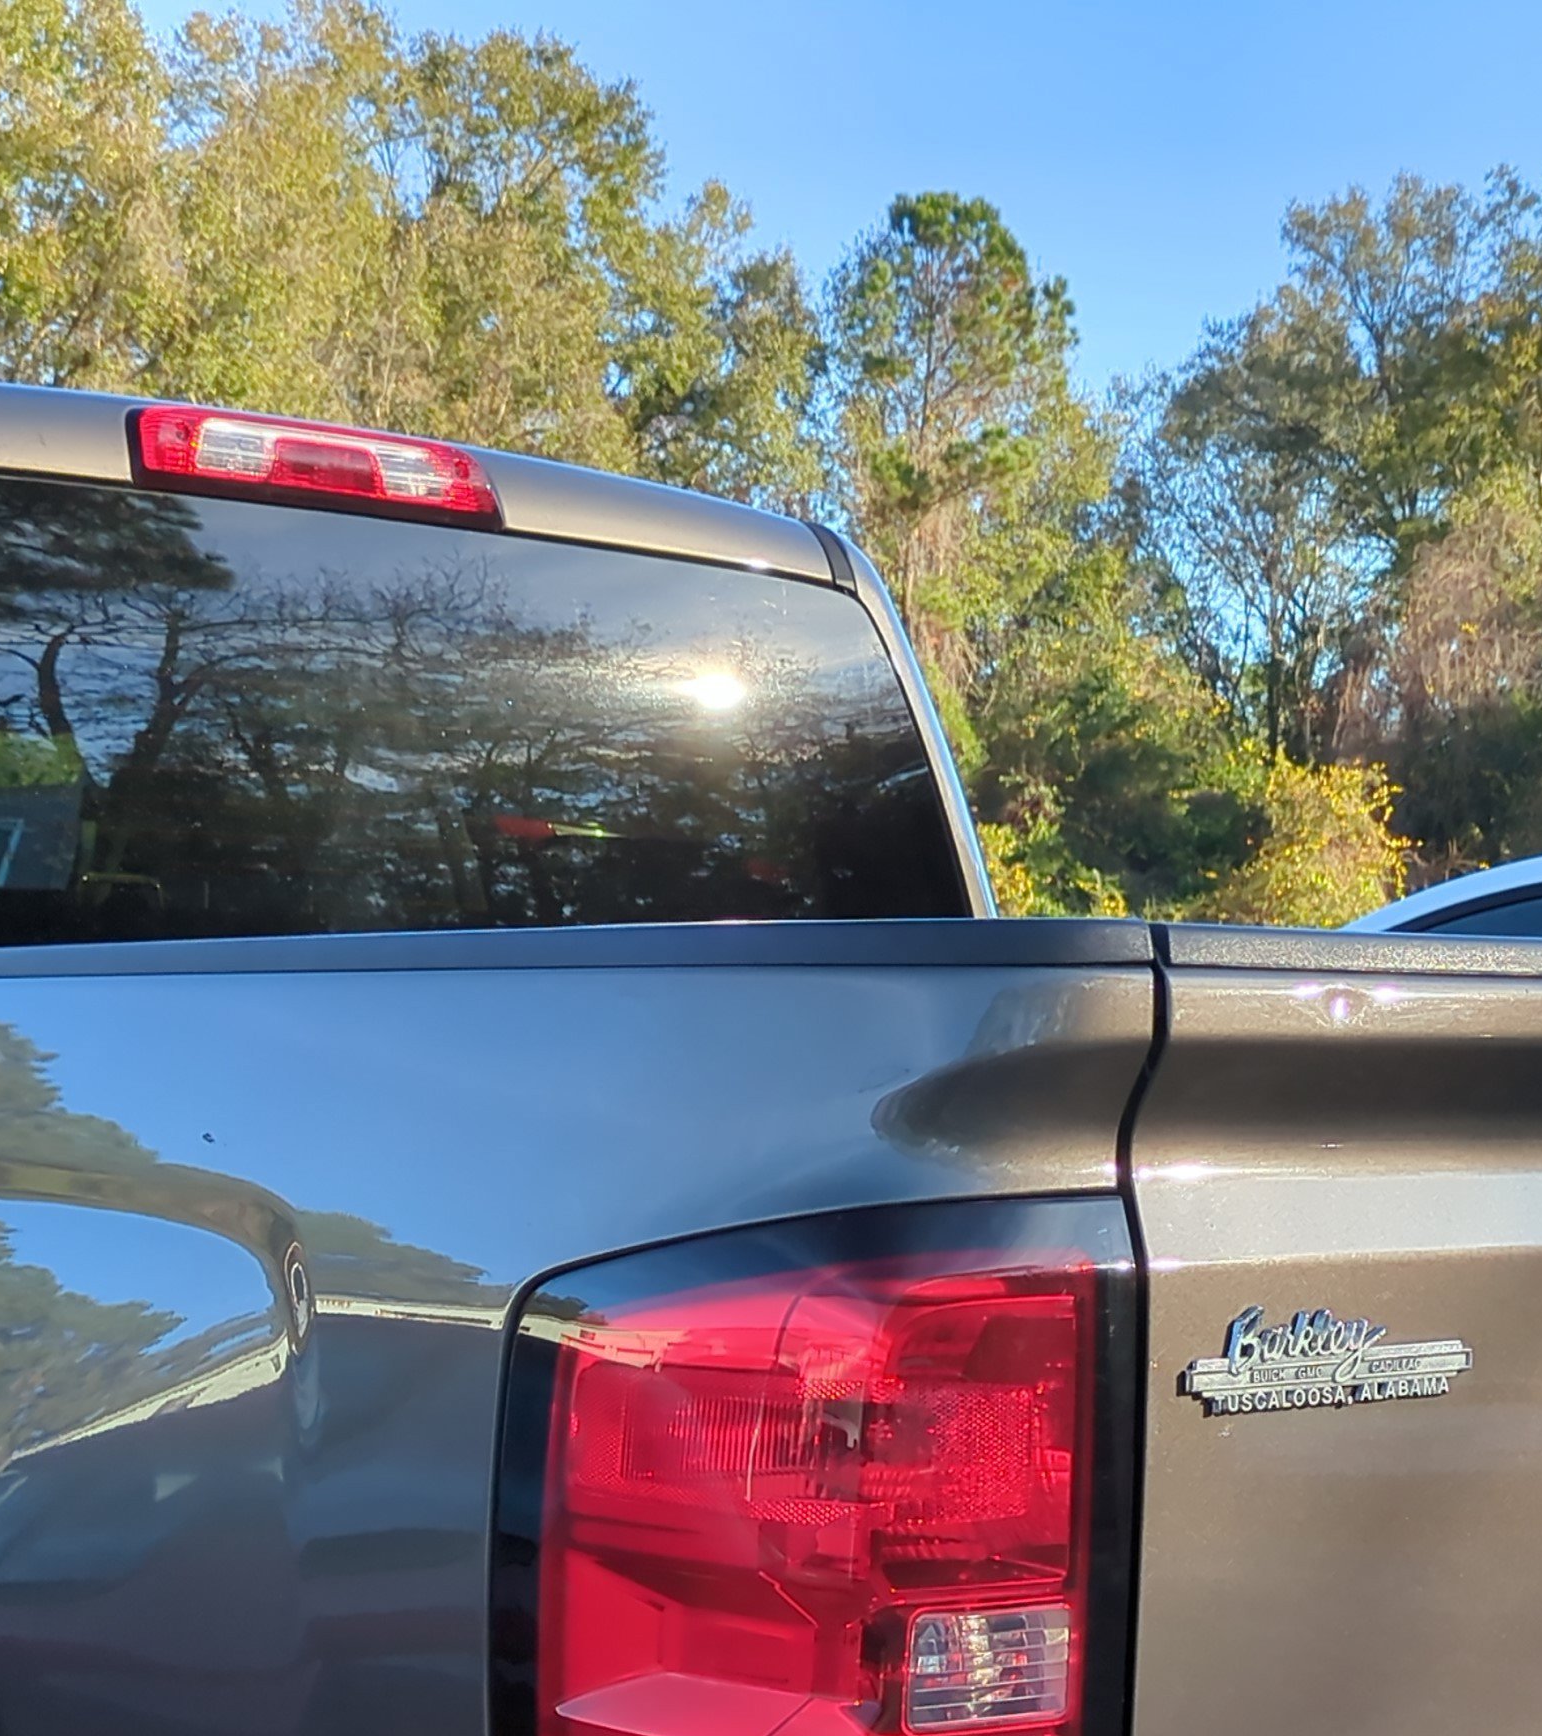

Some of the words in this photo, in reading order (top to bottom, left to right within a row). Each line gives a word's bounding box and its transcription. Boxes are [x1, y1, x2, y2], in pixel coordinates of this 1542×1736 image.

[1253, 1367, 1287, 1383] BUICK
[1297, 1365, 1325, 1379] GMC
[1371, 1358, 1422, 1373] CADILLAC
[1212, 1385, 1354, 1414] TUSCALOOSA,
[1360, 1374, 1450, 1402] ALABAMA
